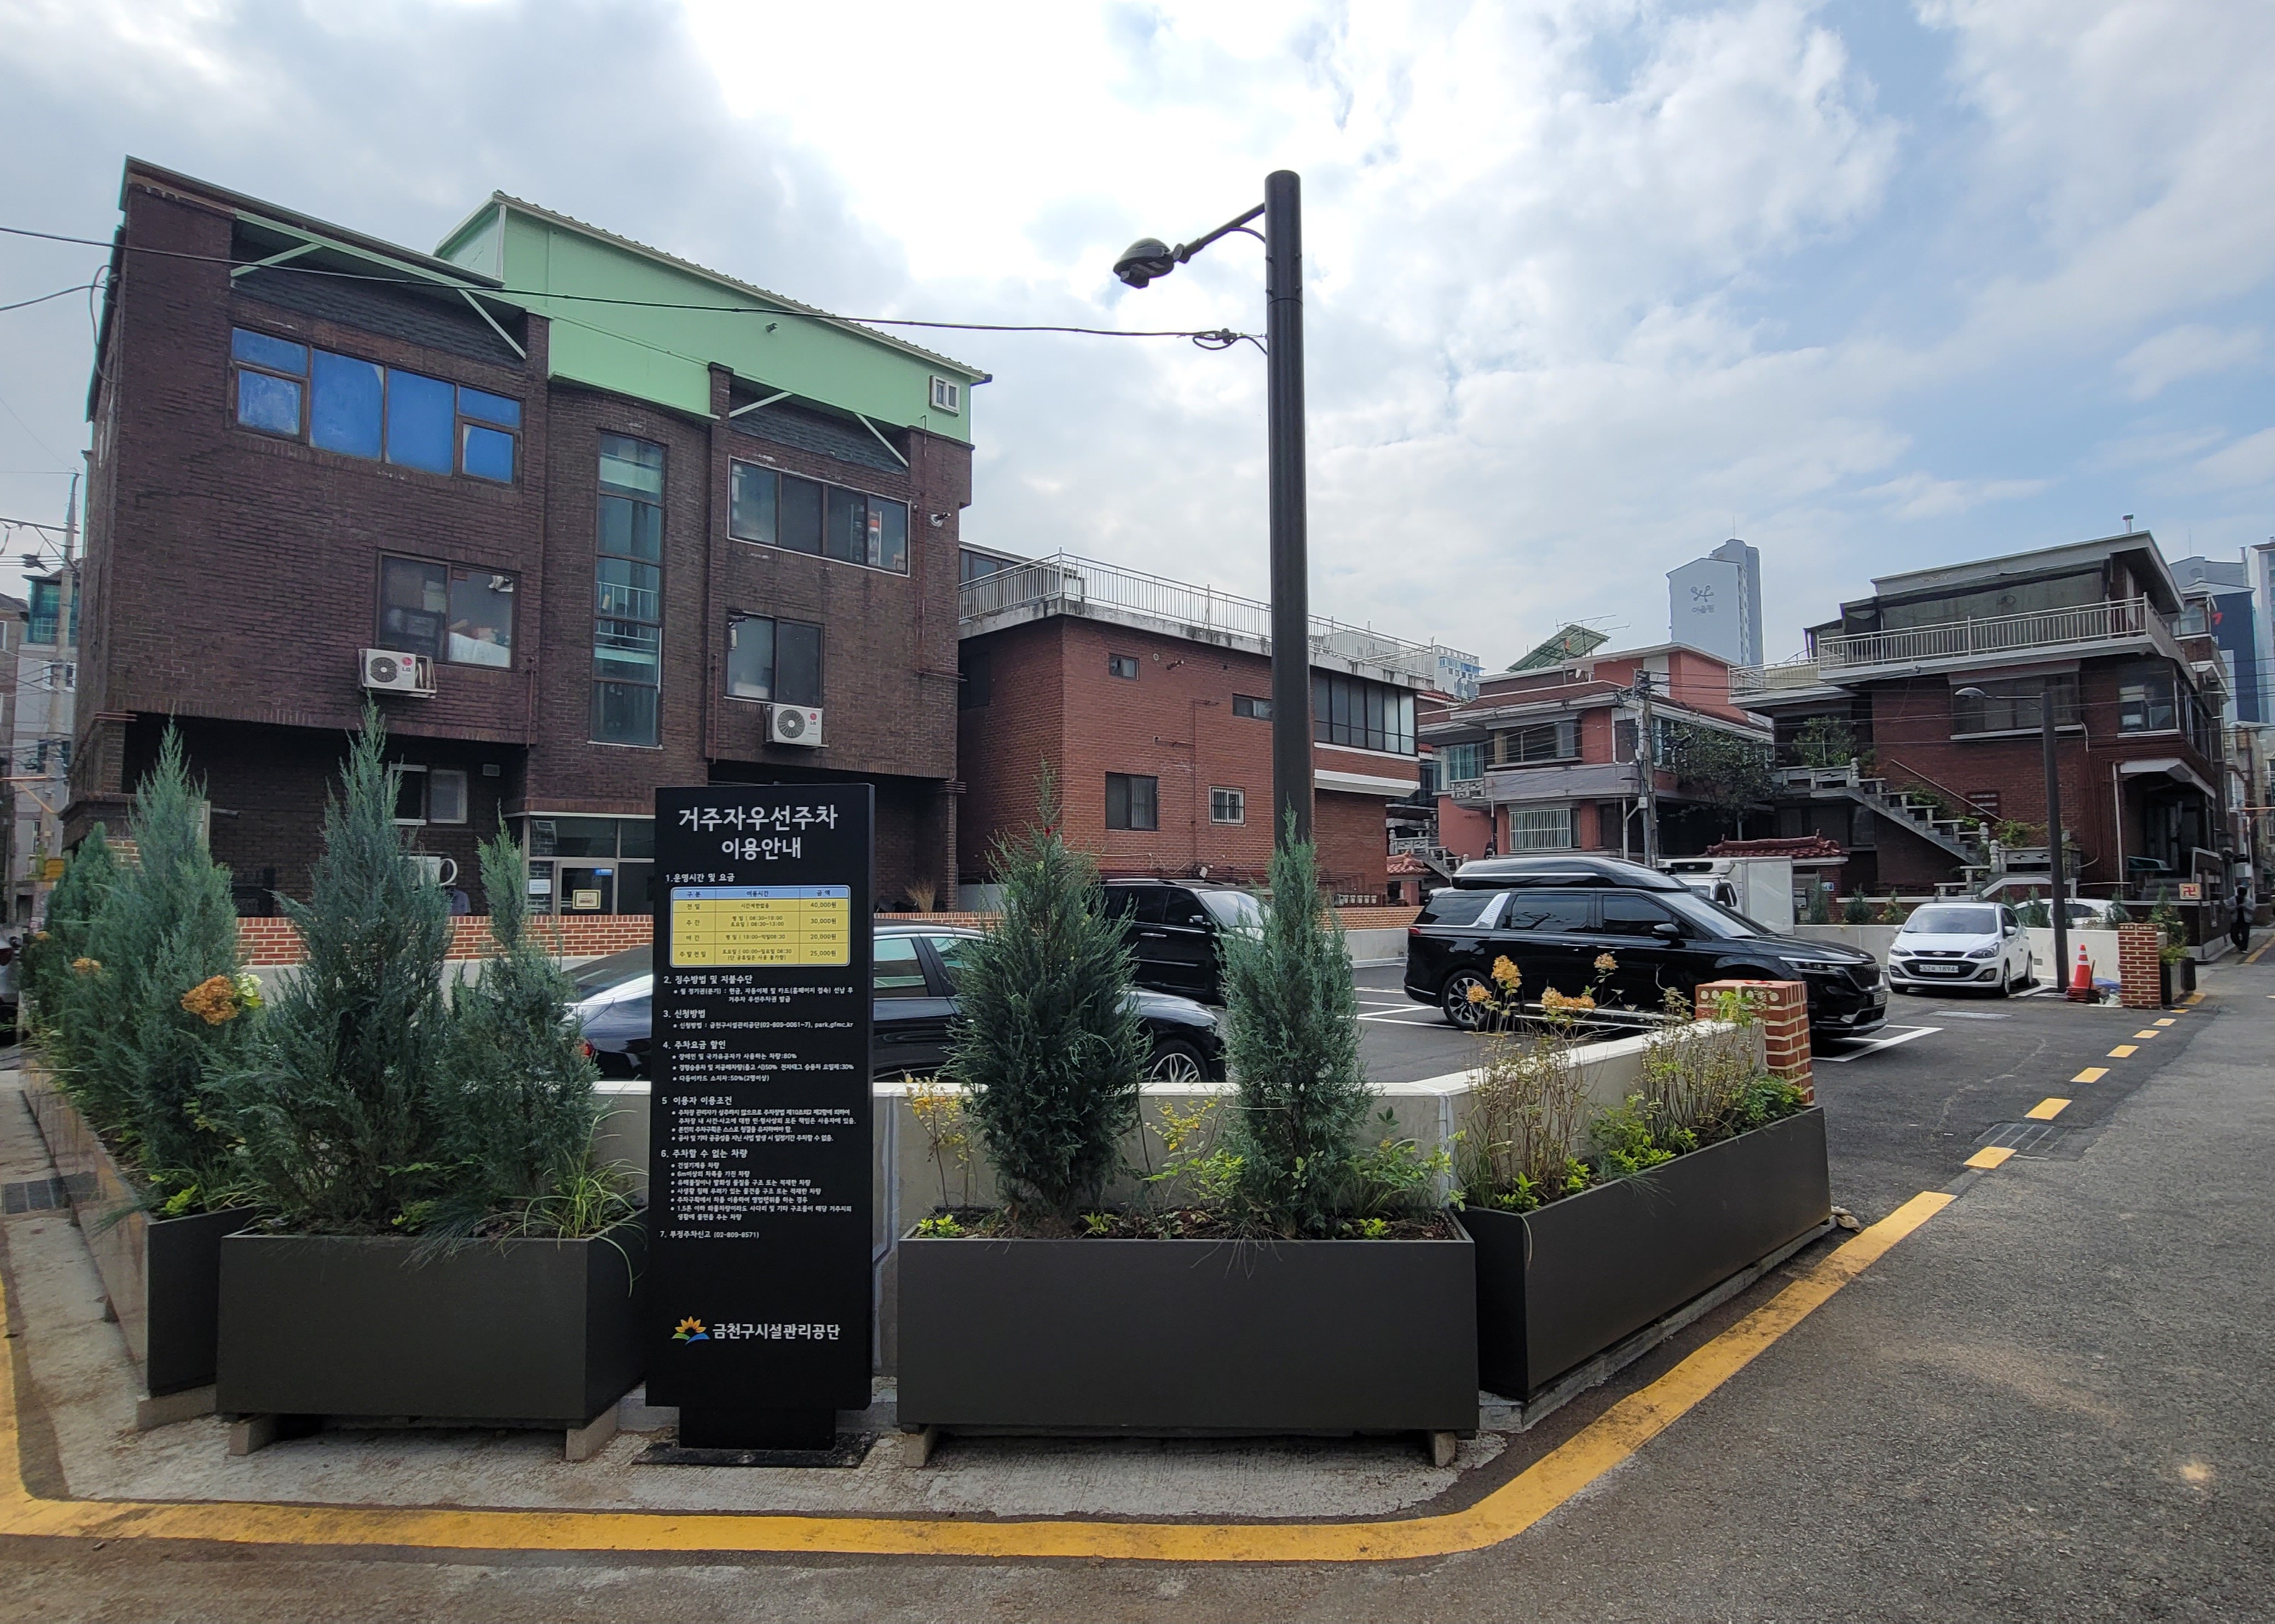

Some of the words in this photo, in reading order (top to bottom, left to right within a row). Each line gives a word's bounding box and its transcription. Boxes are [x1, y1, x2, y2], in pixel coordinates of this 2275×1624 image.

[679, 805, 838, 831] 거주자우선주차
[721, 837, 801, 860] 이용안내
[666, 873, 704, 883] 1.운영시간
[719, 873, 735, 882] 요금
[675, 975, 707, 984] 징수방법
[721, 974, 753, 984] 지불수단
[674, 1009, 705, 1019] 신청방법
[674, 1040, 707, 1050] 주차요금
[710, 1040, 726, 1050] 할인
[672, 1096, 698, 1106] 이용자
[700, 1096, 732, 1106] 이용조건
[672, 1149, 697, 1158] 주차할
[711, 1149, 729, 1158] 없는
[731, 1149, 748, 1158] 차량
[712, 1323, 841, 1340] 금천구시설관리공단
